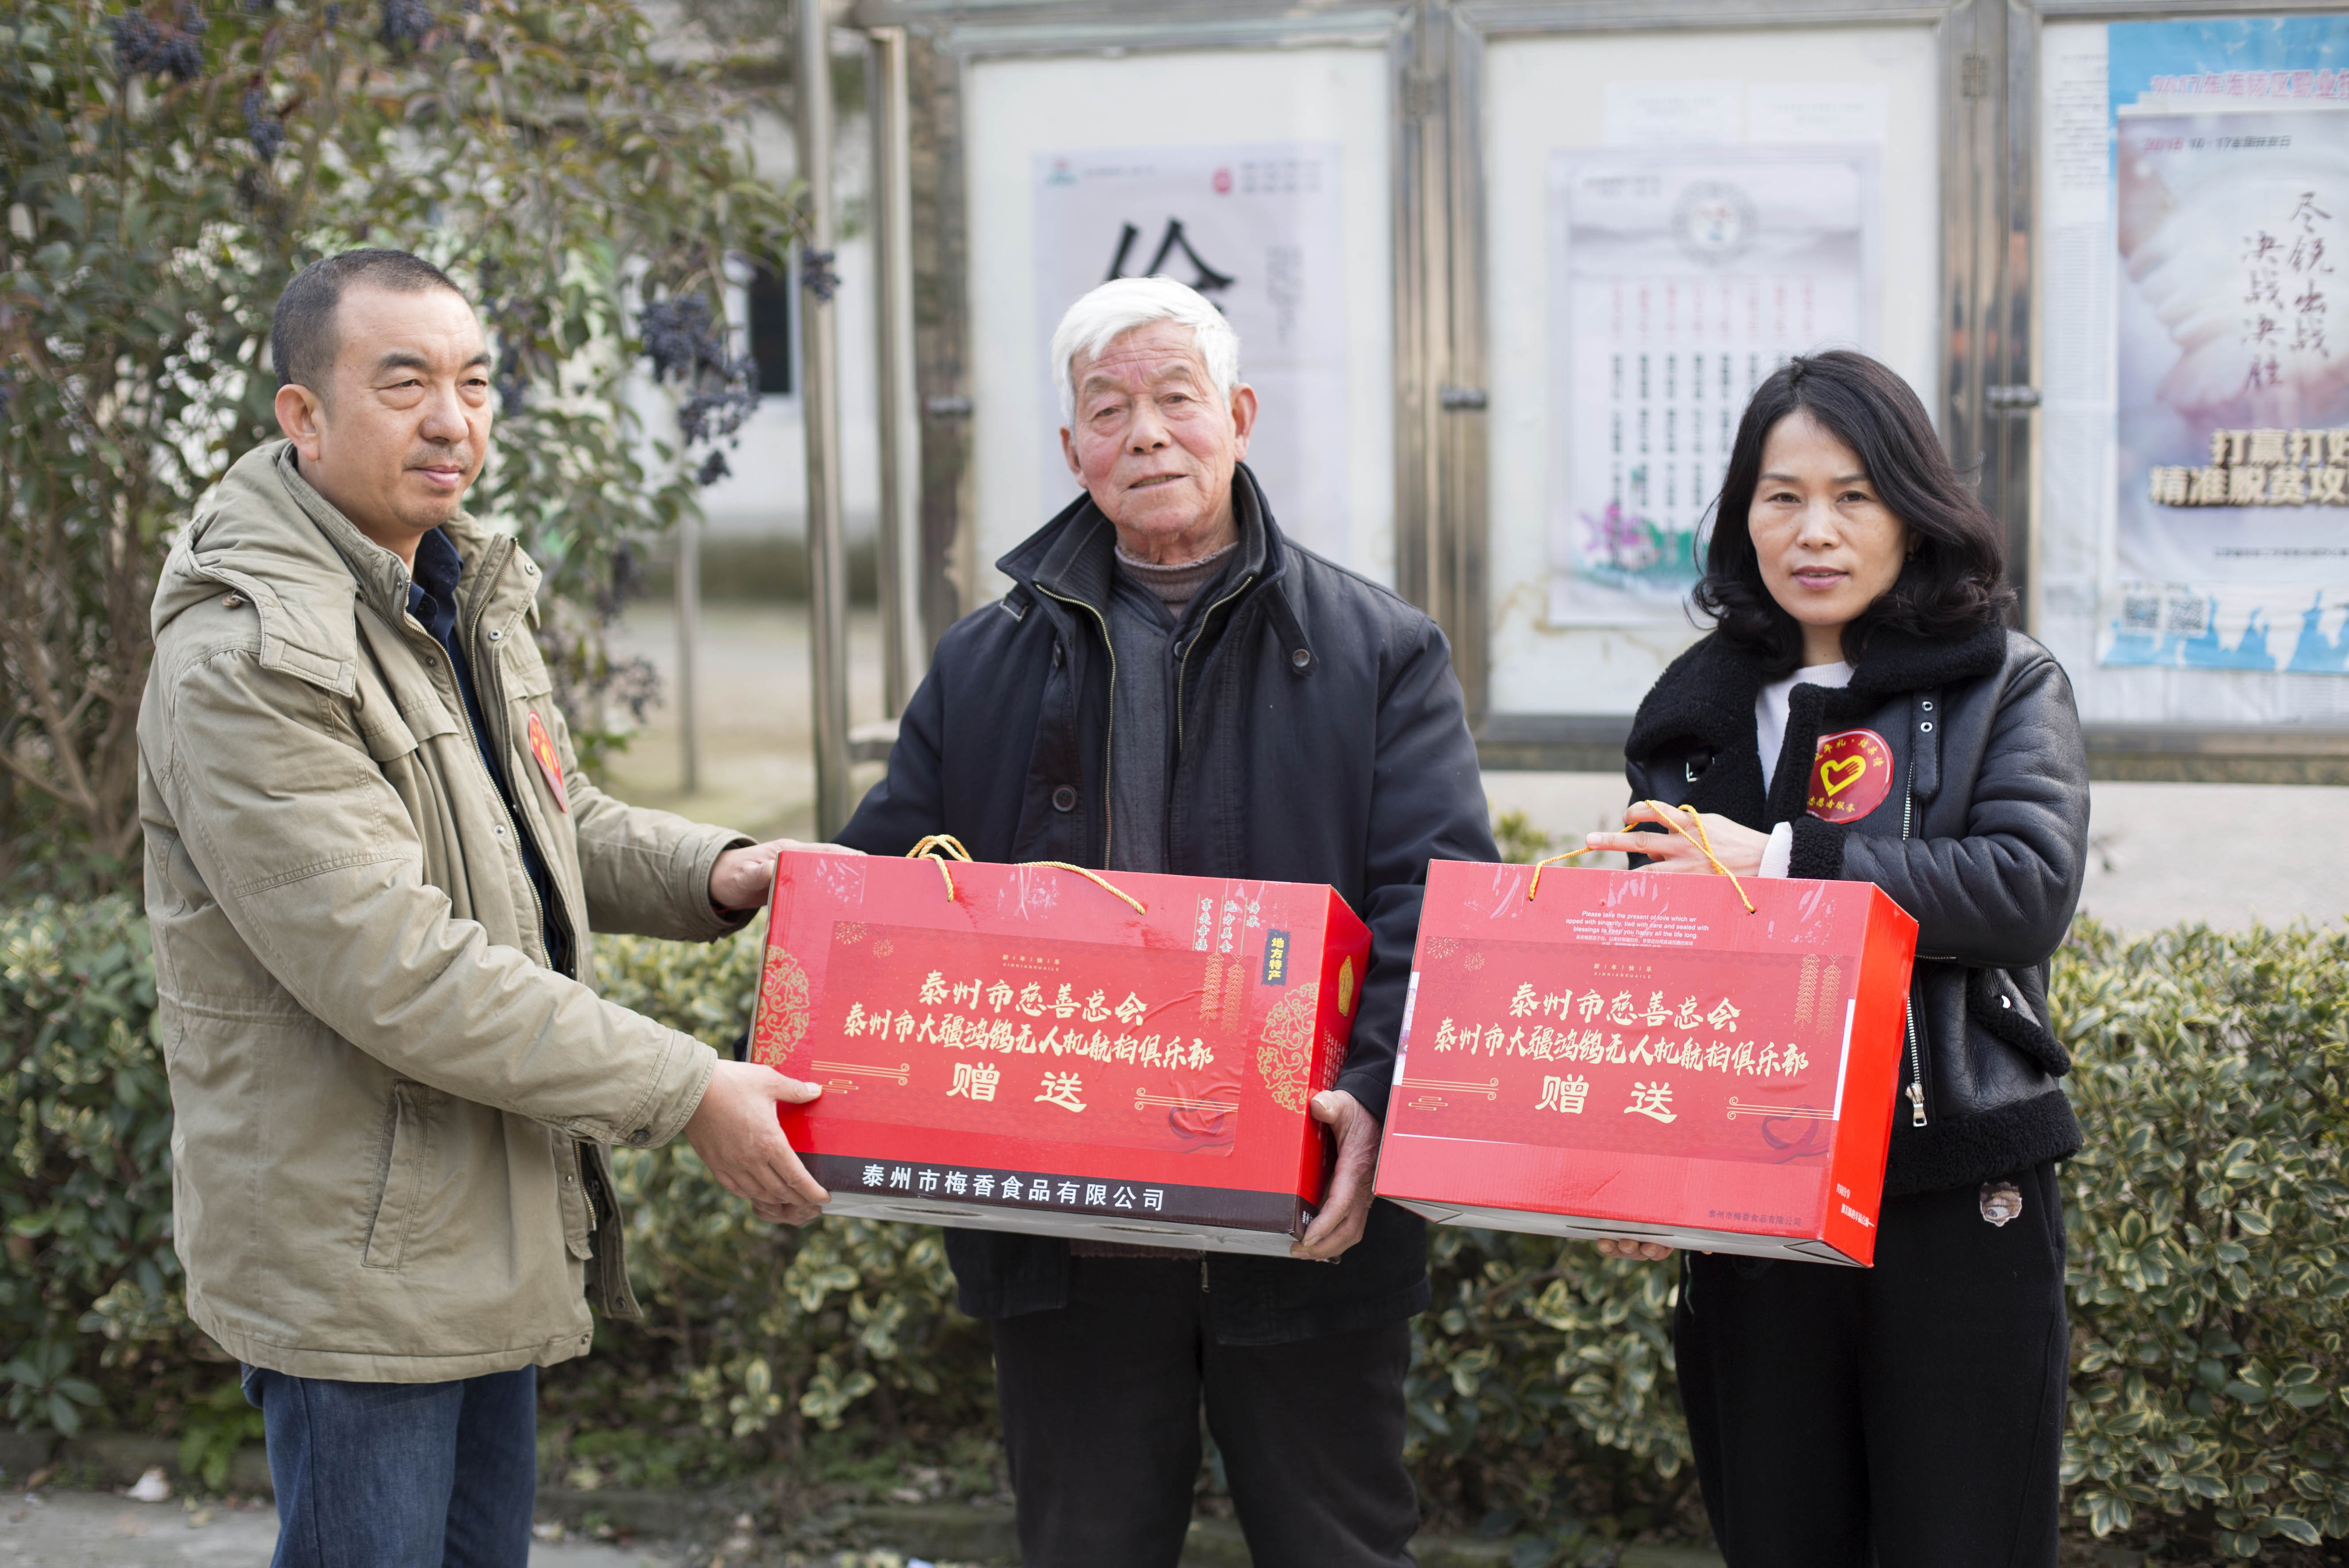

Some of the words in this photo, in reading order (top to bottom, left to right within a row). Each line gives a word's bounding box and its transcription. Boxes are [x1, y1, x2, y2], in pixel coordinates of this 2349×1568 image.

[1003, 963, 1059, 971] XINNIANKUAILE
[1268, 937, 1284, 981] 地方特产
[919, 970, 1148, 1025] 泰州市慈善总会
[1509, 981, 1741, 1032] 泰州市慈善总会
[844, 1002, 1214, 1070] 泰州市大疆鸿鹄无人机航拍俱乐部
[1434, 1017, 1809, 1077] 泰州市大疆鸿鹄无人机航拍俱乐部
[862, 1164, 1164, 1211] 泰州市梅香食品有限公司
[1836, 1183, 1851, 1199] 共同分享
[1708, 1210, 1801, 1226] 泰州市梅香食品有限公司
